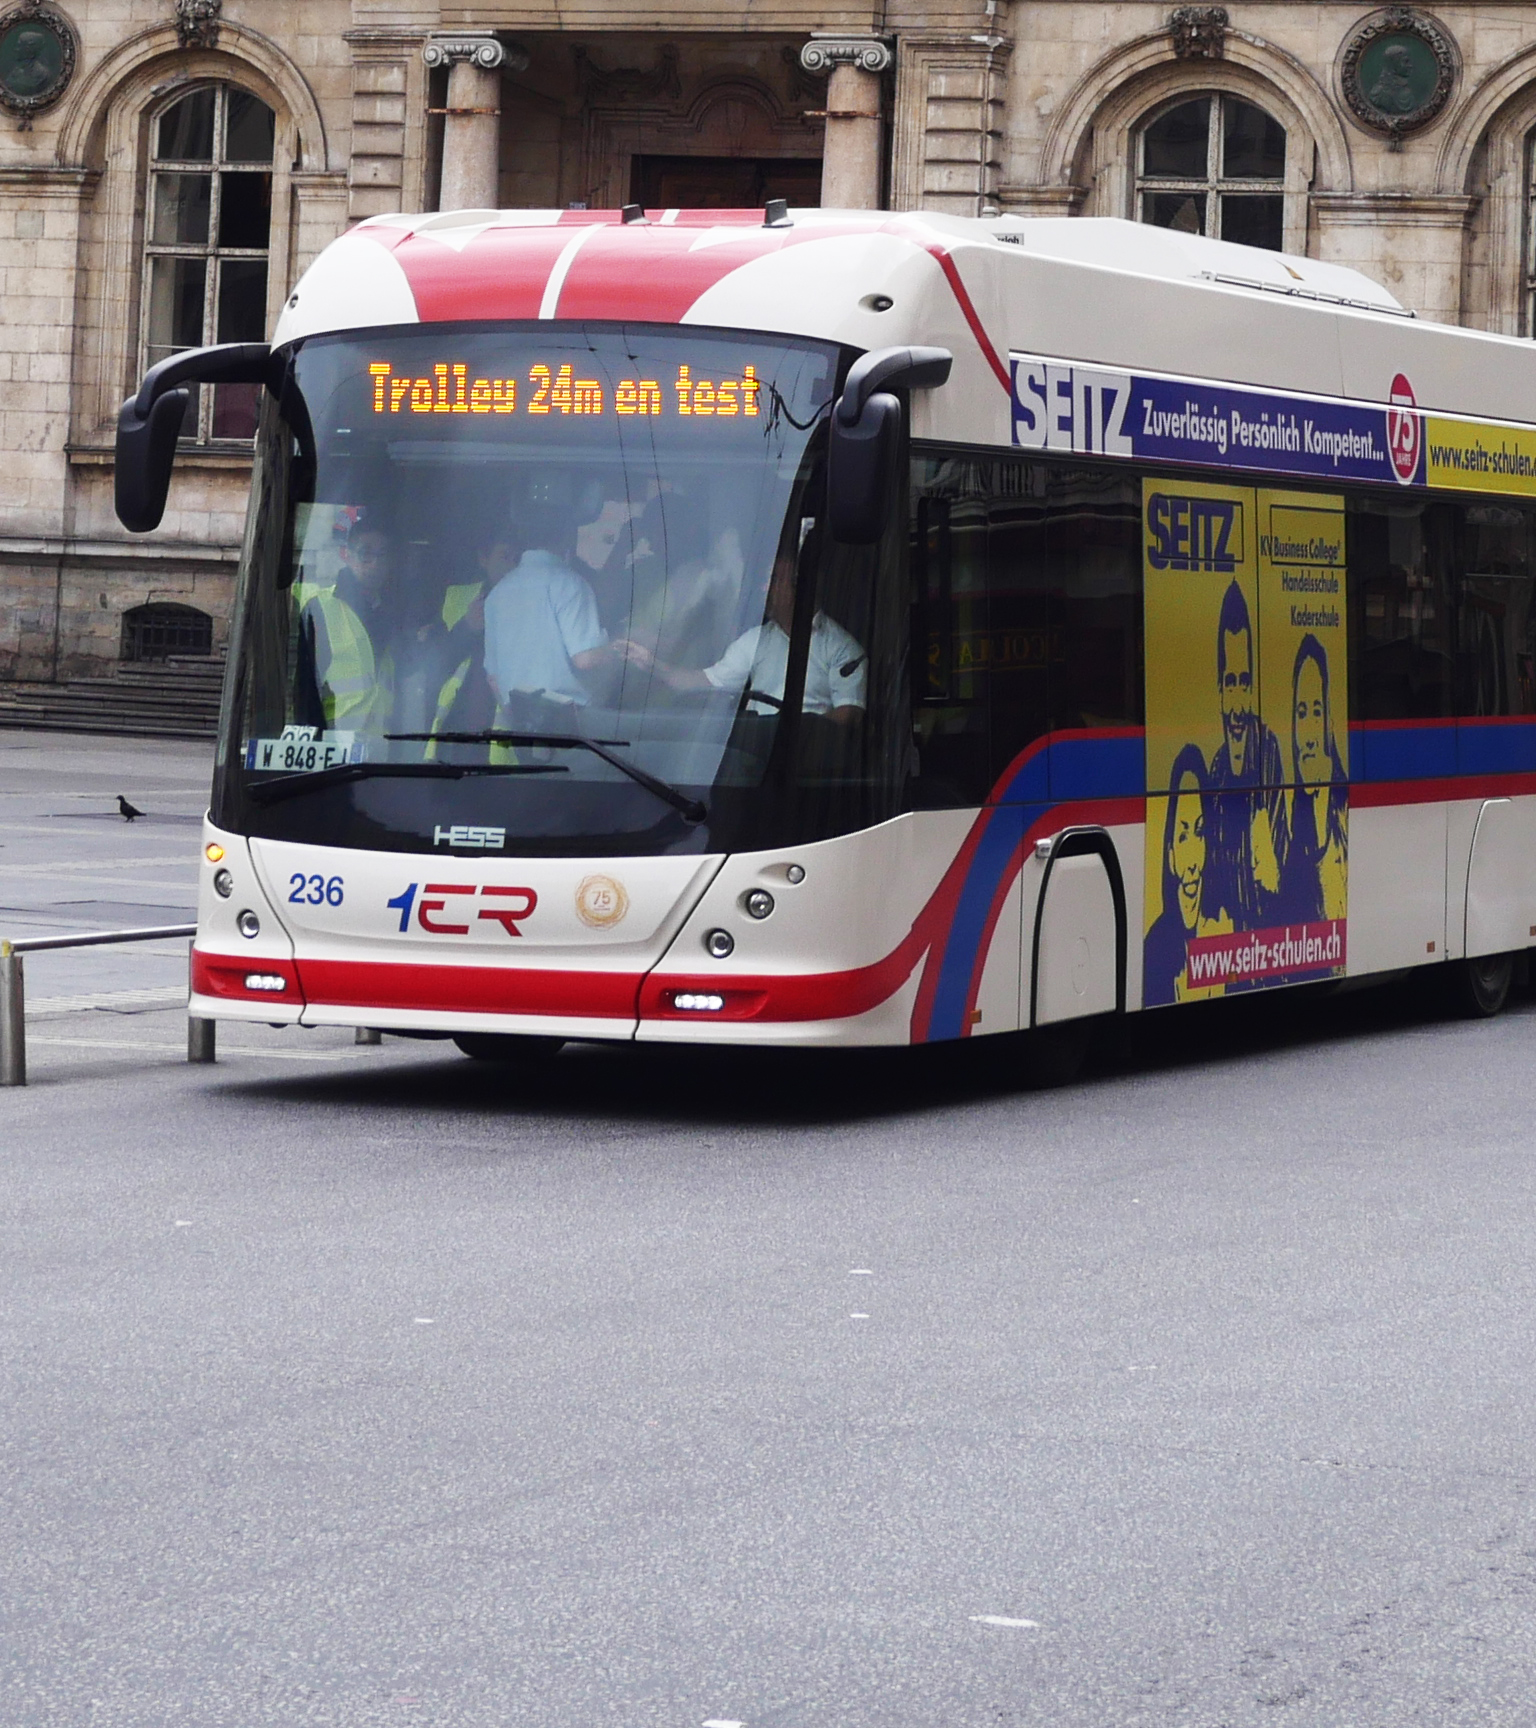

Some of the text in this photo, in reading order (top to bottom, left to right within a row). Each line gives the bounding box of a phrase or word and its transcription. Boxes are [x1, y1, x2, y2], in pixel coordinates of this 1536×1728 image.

[369, 363, 759, 416] Trolley 24m en test
[1015, 360, 1133, 458] SEITZ
[1142, 398, 1227, 455] Zuverlässig
[1231, 410, 1300, 453] Persönlich
[1304, 419, 1384, 466] Kompetent...
[1391, 393, 1414, 453] 75
[1147, 492, 1235, 573] SEITZ
[1274, 536, 1308, 559] Business
[1282, 570, 1339, 593] Handelsschule
[1291, 604, 1340, 627] Kaderschule
[433, 825, 506, 849] HESS
[288, 872, 345, 907] 236
[591, 889, 612, 906] 75
[1190, 921, 1341, 981] www.seitz-schulen.ch
